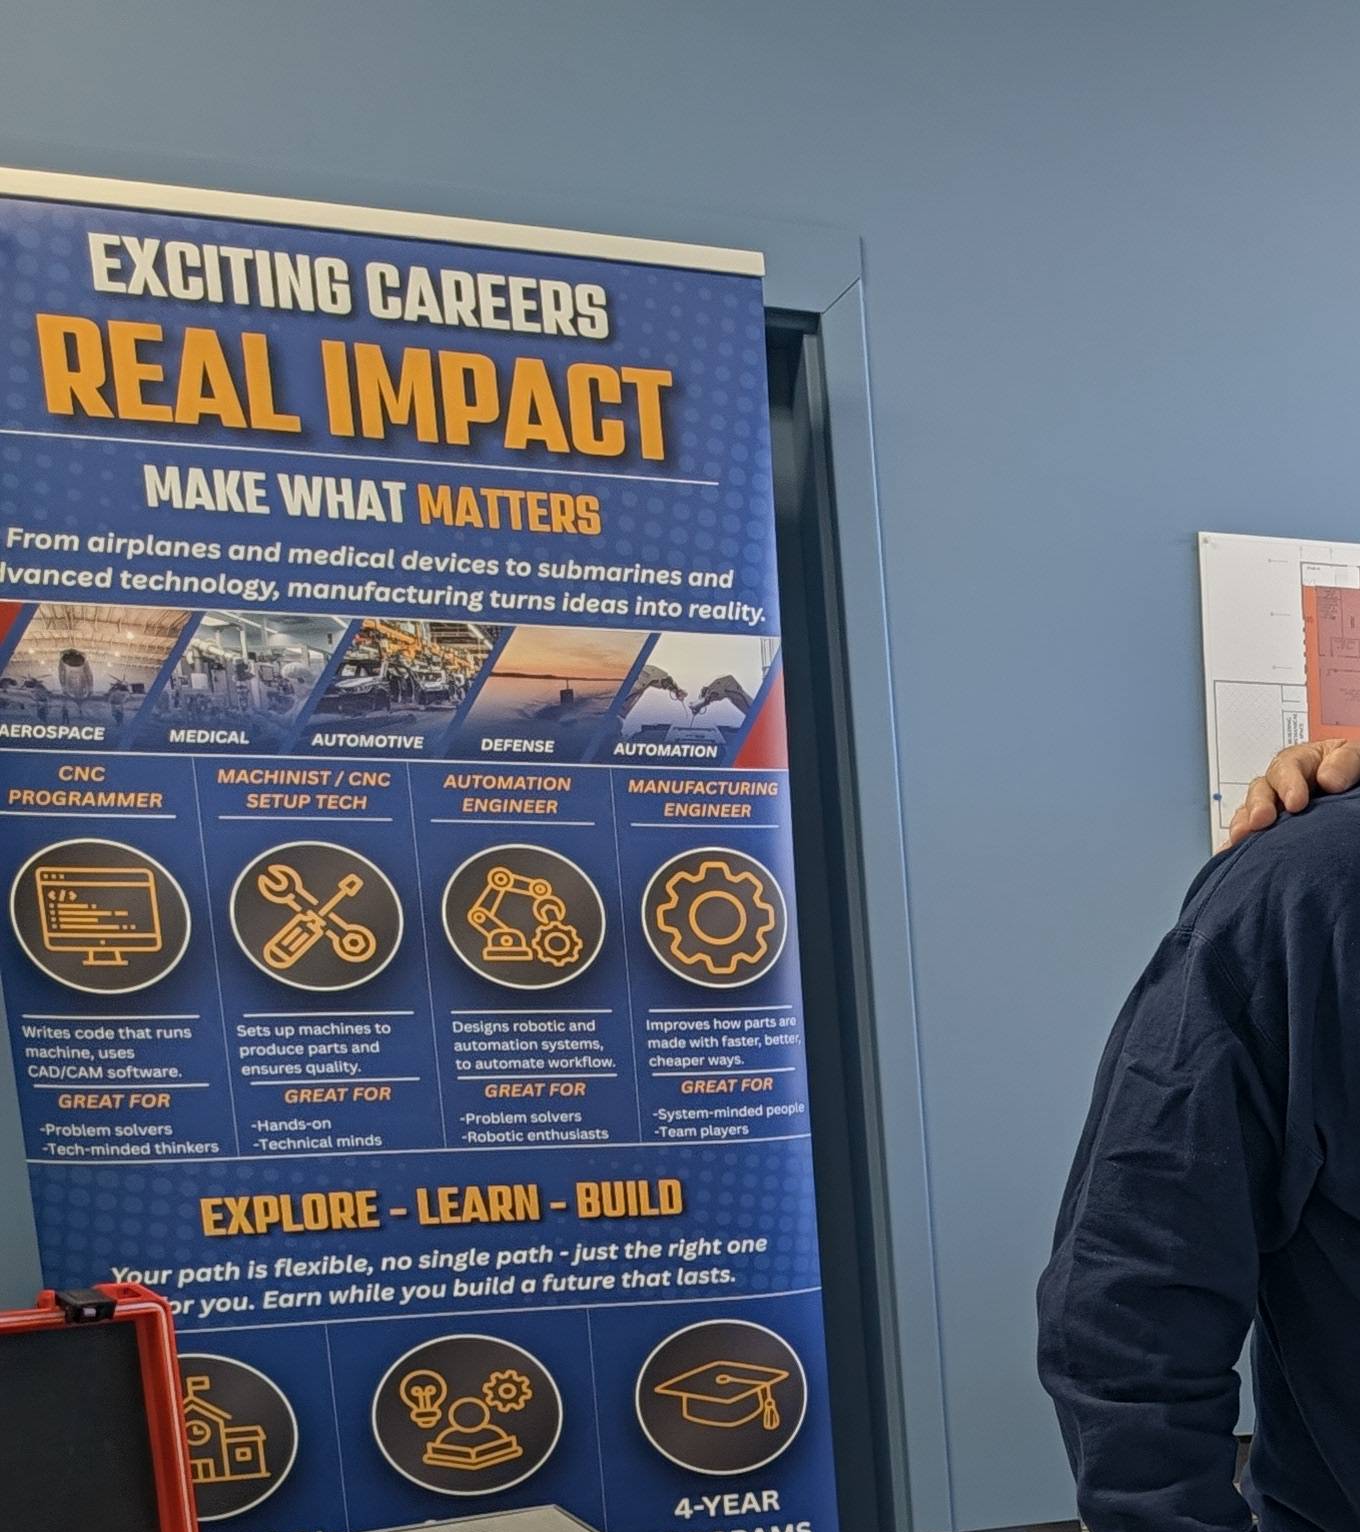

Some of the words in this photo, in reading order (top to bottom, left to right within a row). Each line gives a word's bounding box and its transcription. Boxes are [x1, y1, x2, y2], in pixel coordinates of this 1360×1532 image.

[88, 232, 352, 315] EXCITING
[365, 262, 610, 339] CAREERS
[36, 314, 301, 434] REAL
[321, 339, 673, 460] IMPACT
[143, 464, 269, 514] MAKE
[278, 475, 407, 524] WHAT
[417, 483, 602, 536] MATTERS
[7, 527, 79, 552] From
[87, 532, 221, 560] airplanes
[228, 542, 281, 563] and
[288, 545, 395, 570] medical
[401, 551, 498, 575] devices
[506, 558, 531, 578] to
[538, 560, 681, 586] submarines
[688, 570, 734, 589] and
[120, 569, 280, 601] technology,
[288, 581, 483, 611] manufacturing
[490, 588, 555, 611] turns
[562, 592, 628, 615] ideas
[635, 597, 682, 618] into
[689, 602, 766, 626] reality.
[0, 723, 105, 741] AEROSPACE
[169, 729, 250, 745] MEDICAL
[312, 733, 424, 749] AUTOMOTIVE
[481, 738, 554, 753] DEFENSE
[614, 742, 718, 758] AUTOMATION
[58, 766, 105, 782] CNC
[217, 769, 331, 785] MACHINIST
[348, 771, 391, 787] CNC
[443, 774, 571, 792] AUTOMATION
[628, 779, 778, 796] MANUFACTURING
[8, 789, 163, 808] PROGRAMMER
[246, 794, 311, 809] SETUP
[316, 795, 367, 810] TECH
[462, 798, 558, 814] ENGINEER
[663, 803, 752, 818] ENGINEER
[22, 1026, 71, 1039] Writes
[75, 1026, 115, 1040] code
[118, 1026, 152, 1039] that
[156, 1027, 192, 1039] runs
[236, 1025, 271, 1037] Sets
[275, 1026, 294, 1039] up
[299, 1023, 371, 1035] machines
[375, 1023, 391, 1034] to
[452, 1021, 509, 1035] Designs
[513, 1020, 565, 1032] robotic
[568, 1020, 596, 1031] and
[646, 1020, 710, 1033] Improves
[713, 1018, 741, 1029] how
[744, 1018, 776, 1032] parts
[779, 1018, 797, 1027] are
[239, 1043, 304, 1058] produce
[308, 1043, 348, 1057] parts
[351, 1041, 380, 1053] and
[454, 1039, 538, 1051] automation
[541, 1039, 604, 1052] systems,
[648, 1038, 686, 1049] made
[689, 1036, 719, 1048] with
[722, 1035, 762, 1049] faster,
[765, 1034, 801, 1046] better,
[25, 1047, 95, 1061] machine,
[98, 1048, 135, 1059] uses
[241, 1064, 302, 1075] ensures
[306, 1061, 361, 1075] quality.
[455, 1059, 471, 1070] to
[475, 1057, 544, 1069] automate
[548, 1056, 616, 1068] workflow.
[649, 1056, 705, 1069] cheaper
[708, 1056, 744, 1067] ways.
[28, 1065, 103, 1079] CAD/CAM
[107, 1065, 182, 1078] software.
[58, 1094, 125, 1109] GREAT
[129, 1094, 171, 1108] FOR
[284, 1088, 348, 1104] GREAT
[353, 1087, 392, 1101] FOR
[653, 1105, 763, 1121] -System-minded
[767, 1102, 805, 1118] people
[40, 1124, 111, 1136] -Problem
[115, 1124, 172, 1136] solvers
[251, 1119, 332, 1131] -Hands-on
[654, 1126, 697, 1137] -Team
[701, 1125, 749, 1138] players
[253, 1137, 333, 1150] -Technical
[337, 1135, 382, 1147] minds
[461, 1131, 524, 1143] -Robotic
[527, 1129, 609, 1141] enthusiasts
[42, 1142, 151, 1156] -Tech-minded
[155, 1142, 219, 1153] thinkers
[200, 1190, 380, 1237] EXPLORE
[416, 1184, 540, 1226] LEARN
[576, 1178, 684, 1218] BUILD
[111, 1267, 172, 1286] Your
[178, 1262, 239, 1288] path
[248, 1262, 268, 1280] is
[274, 1255, 373, 1277] flexible,
[381, 1254, 412, 1271] no
[418, 1247, 490, 1272] single
[496, 1245, 553, 1269] path
[570, 1241, 619, 1266] just
[624, 1240, 663, 1259] the
[669, 1238, 721, 1261] right
[727, 1237, 767, 1254] one
[169, 1297, 196, 1316] or
[199, 1295, 255, 1318] you.
[263, 1290, 321, 1310] Earn
[327, 1284, 395, 1305] while
[401, 1284, 447, 1303] you
[453, 1274, 515, 1297] build
[521, 1278, 536, 1294] a
[543, 1270, 616, 1292] future
[621, 1269, 671, 1288] that
[676, 1268, 736, 1285] lasts.
[674, 1490, 780, 1519] 4-YEAR
